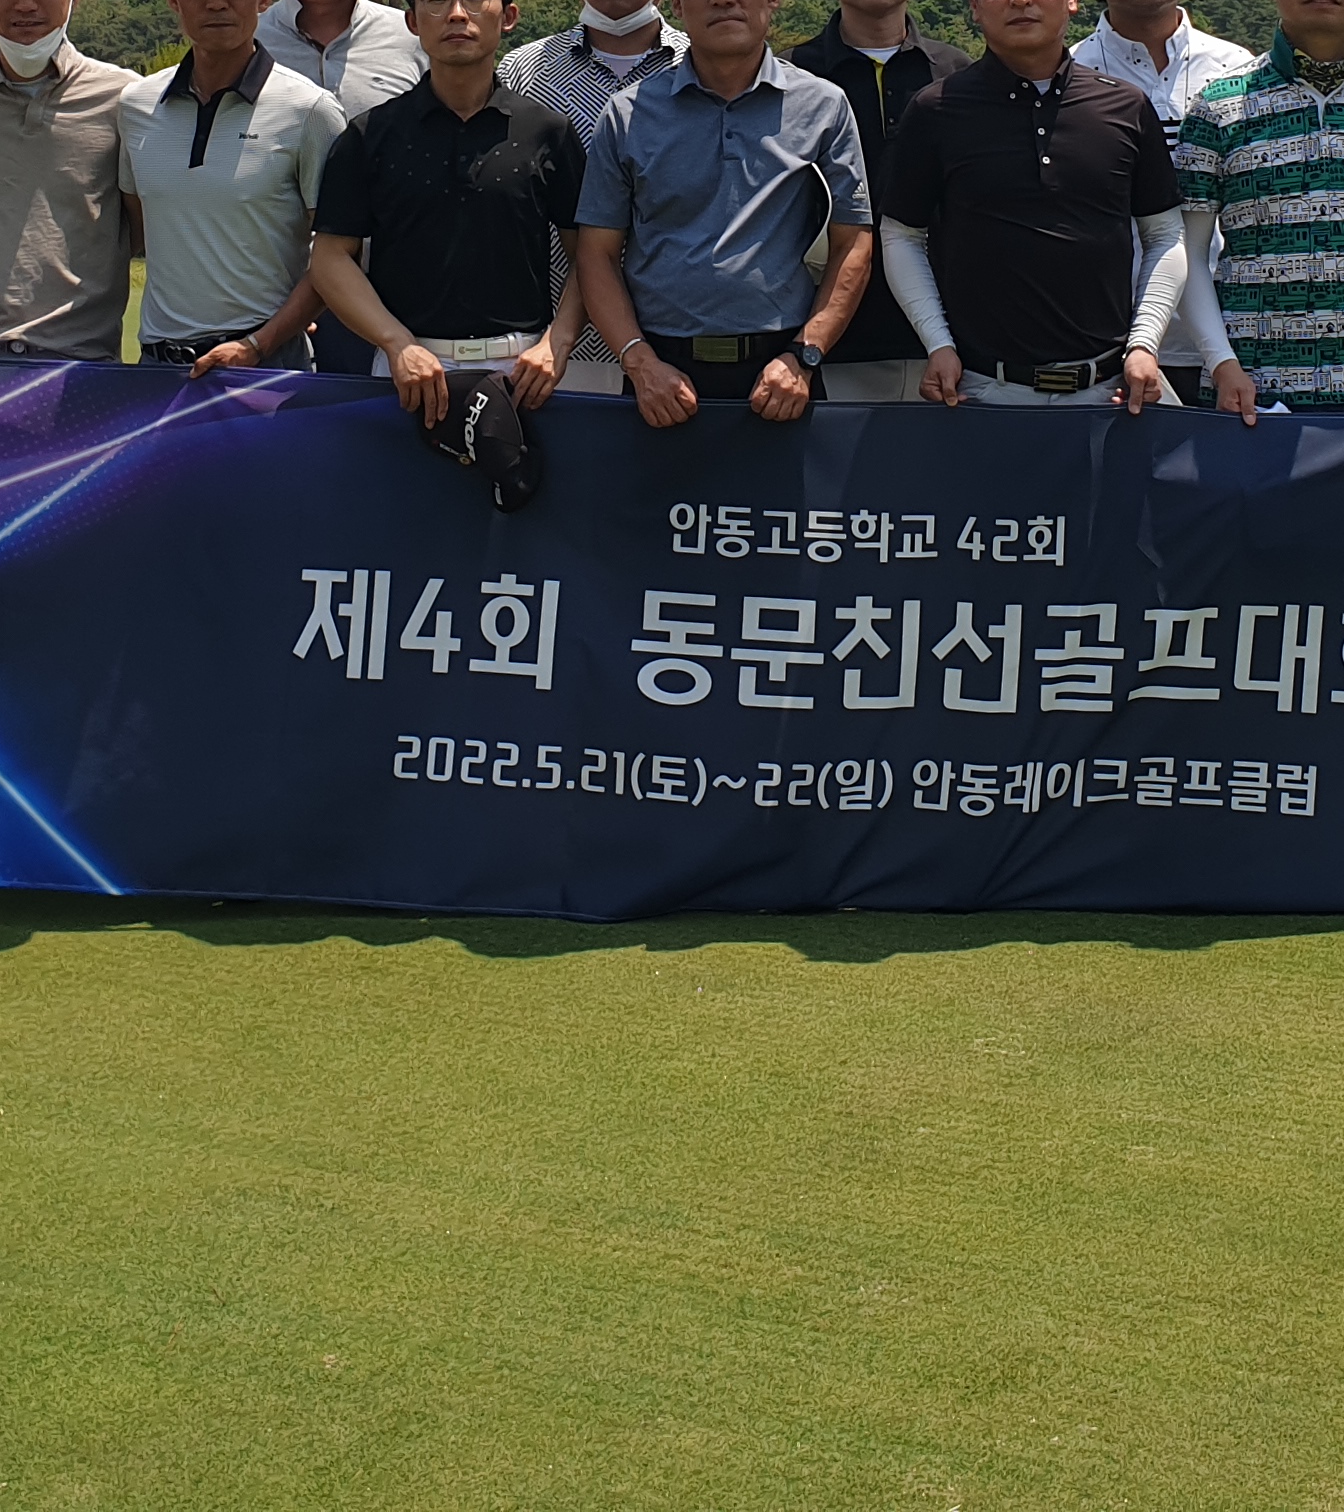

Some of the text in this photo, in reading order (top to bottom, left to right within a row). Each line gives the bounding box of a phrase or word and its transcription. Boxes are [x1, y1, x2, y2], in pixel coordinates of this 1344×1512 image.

[669, 503, 1066, 567] 안동고등학교 42회
[292, 568, 561, 691] 제4회
[393, 735, 1317, 817] 2022.5.21(토)~22(일) 안동레이크골프클럽
